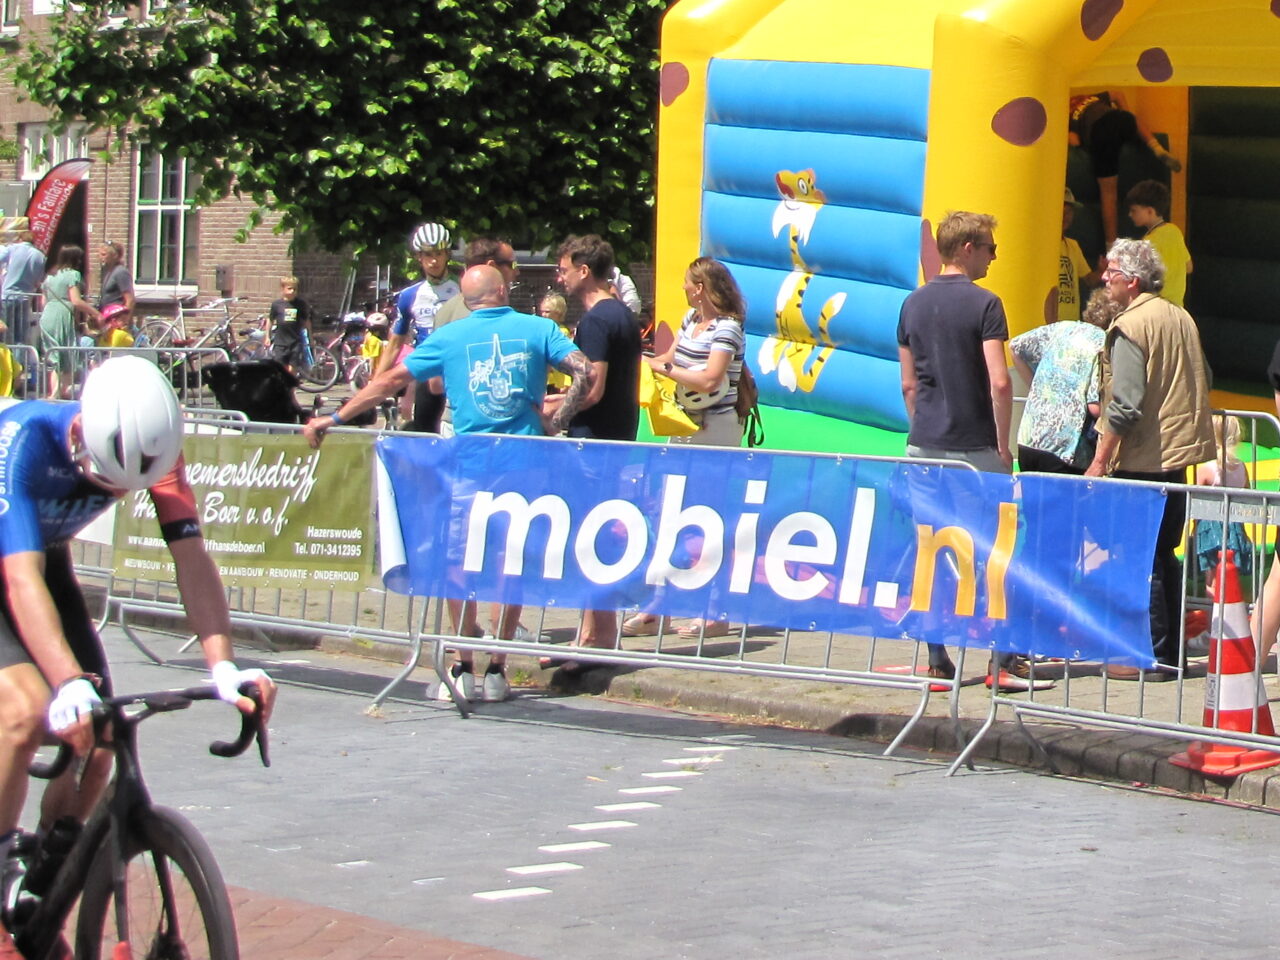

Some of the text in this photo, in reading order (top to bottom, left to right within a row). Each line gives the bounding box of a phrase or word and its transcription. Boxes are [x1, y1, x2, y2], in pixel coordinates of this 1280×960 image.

[37, 179, 67, 212] Fanfare
[204, 491, 240, 523] Boer
[307, 526, 362, 539] Hazerswoude
[294, 542, 308, 554] Tel.
[463, 474, 1018, 620] mobiel.nl
[269, 568, 307, 579] RENOVATIE
[314, 570, 359, 581] ONDERHOUD
